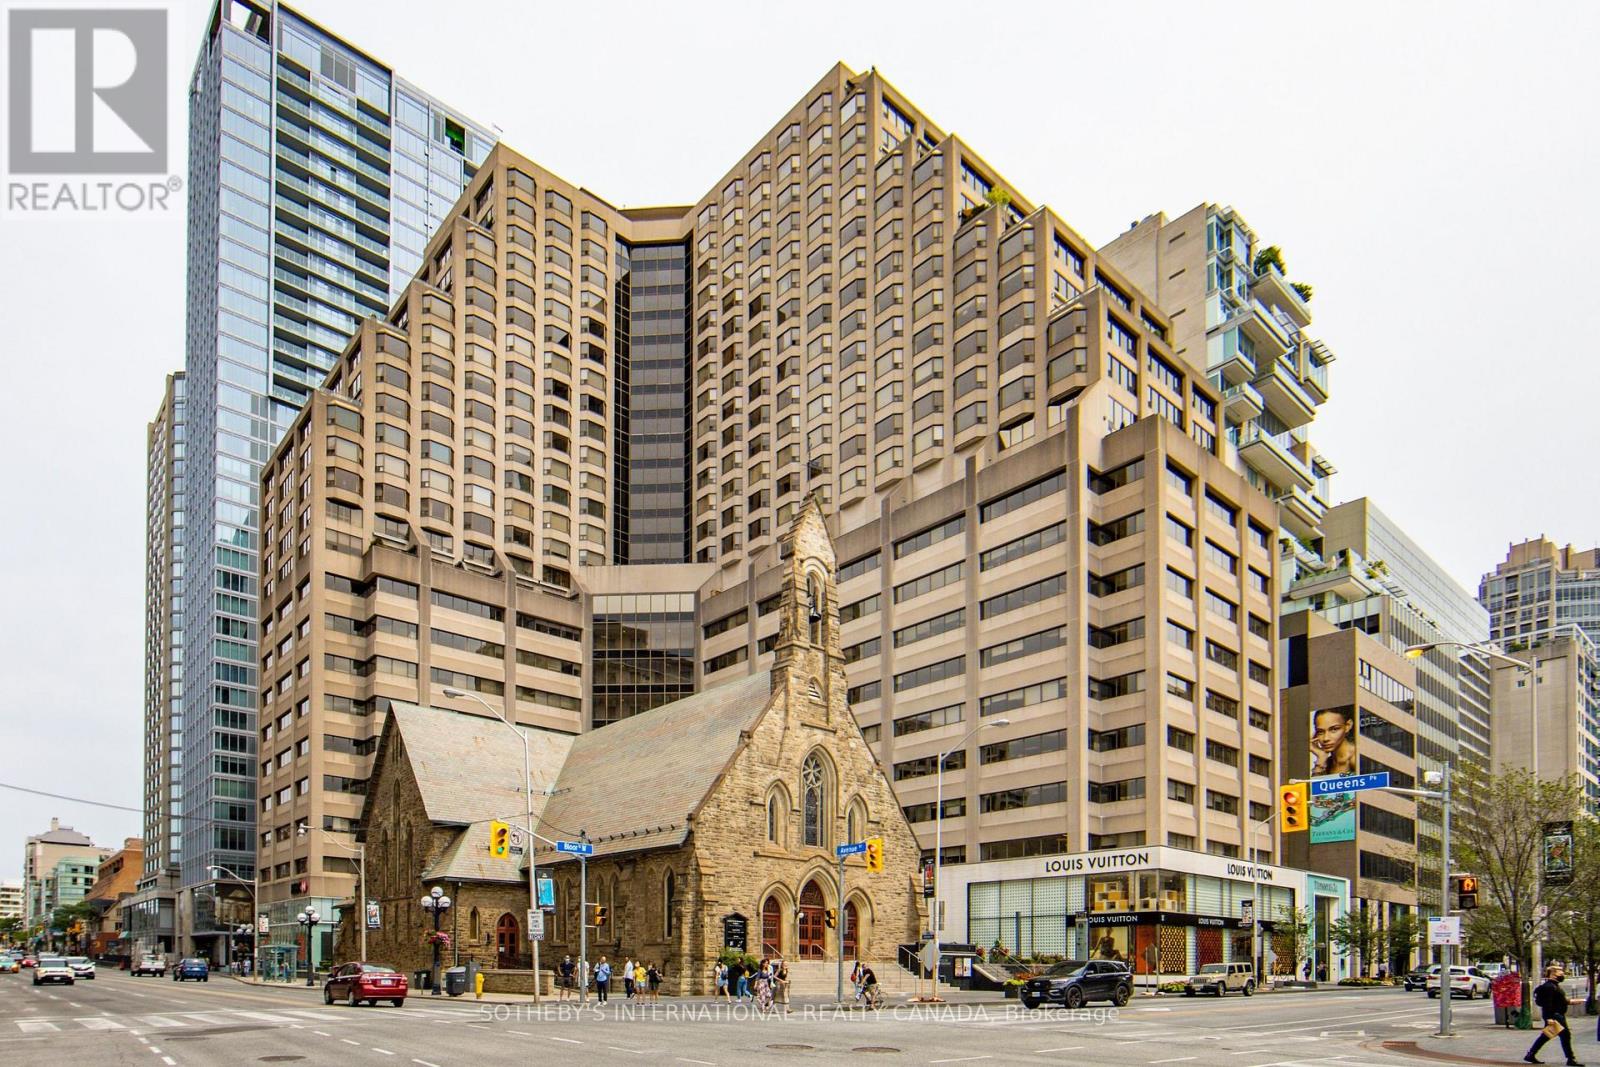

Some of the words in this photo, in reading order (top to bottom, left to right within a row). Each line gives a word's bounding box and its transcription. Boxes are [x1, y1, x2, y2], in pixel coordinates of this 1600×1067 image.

[1319, 778, 1366, 791] Queens
[1046, 858, 1083, 873] LOUIS
[1088, 853, 1149, 869] VUITTON
[1227, 863, 1246, 877] LOUIS
[1247, 866, 1273, 880] VUTTON
